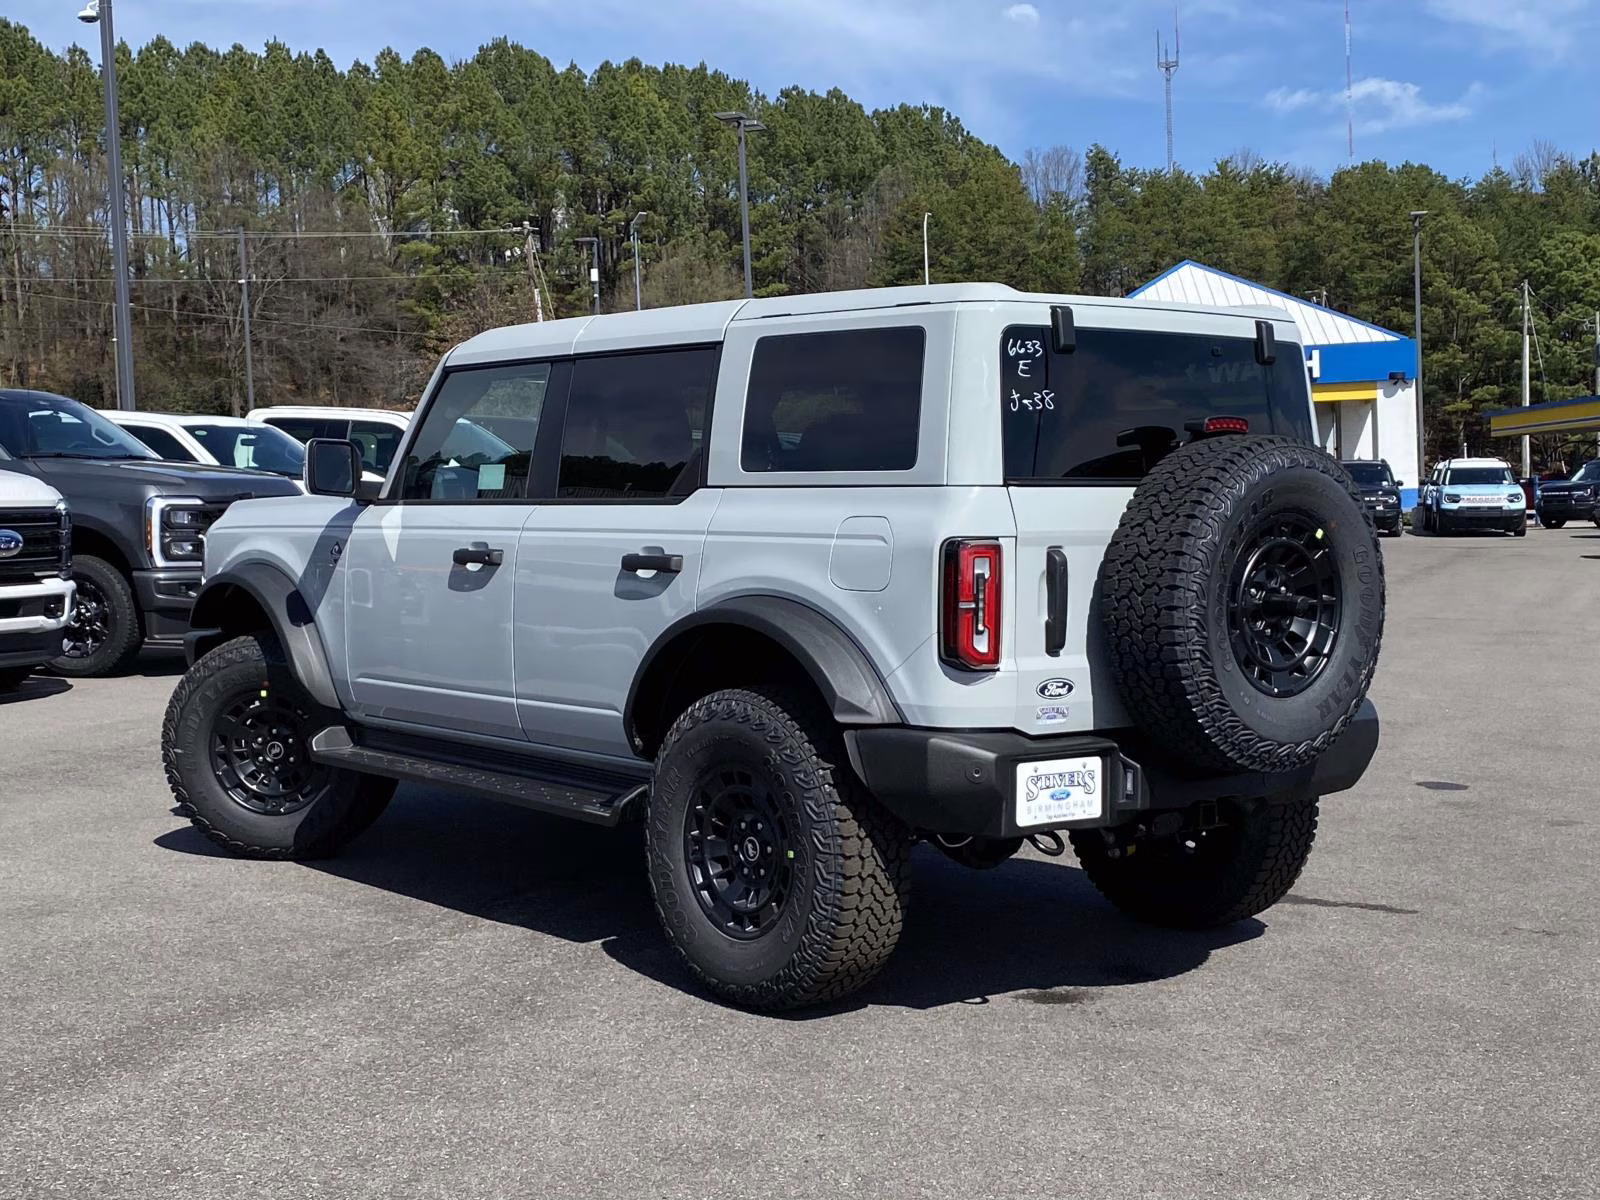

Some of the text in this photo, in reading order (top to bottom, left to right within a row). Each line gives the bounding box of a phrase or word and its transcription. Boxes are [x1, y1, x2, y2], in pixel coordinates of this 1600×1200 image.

[1007, 338, 1043, 357] 6633
[1017, 359, 1032, 377] E
[1316, 544, 1376, 722] GOODYEAR
[1026, 769, 1096, 802] STIVERS
[1026, 799, 1093, 815] BIRMINGHAM
